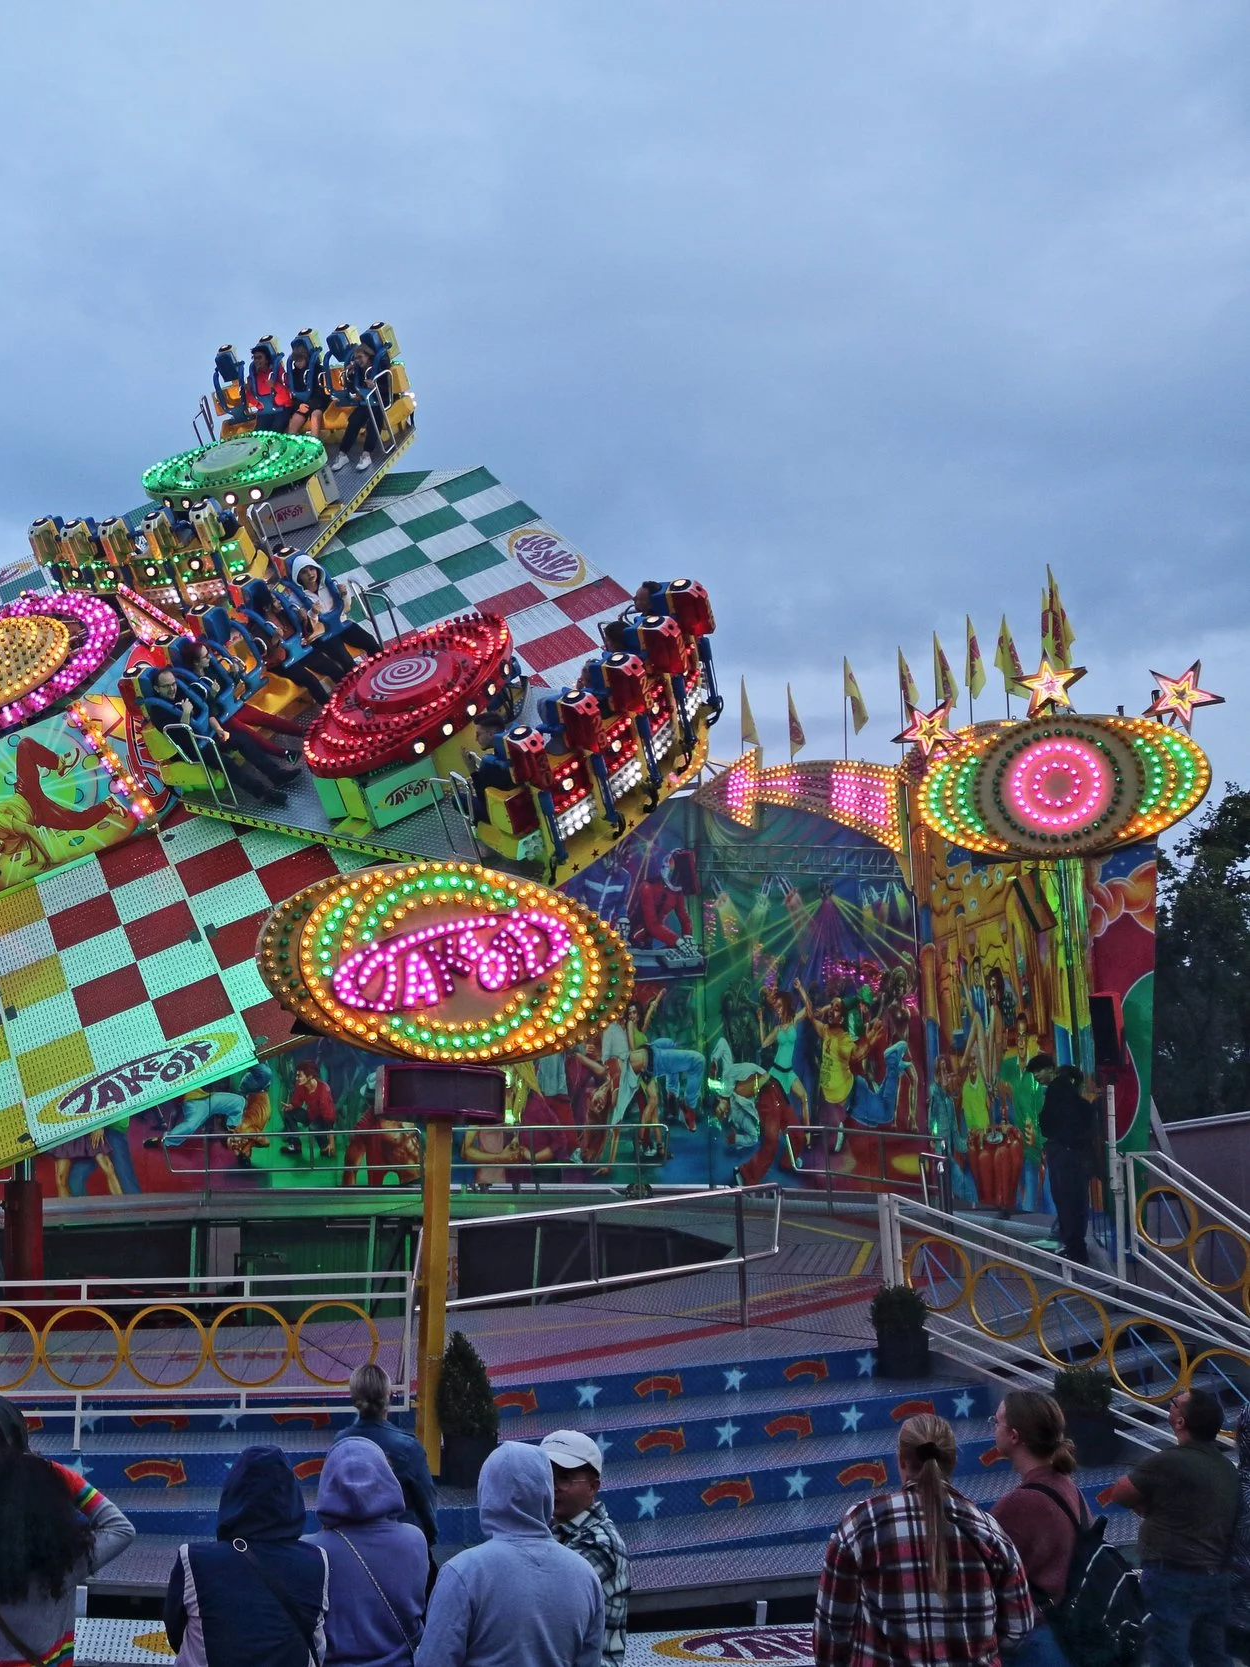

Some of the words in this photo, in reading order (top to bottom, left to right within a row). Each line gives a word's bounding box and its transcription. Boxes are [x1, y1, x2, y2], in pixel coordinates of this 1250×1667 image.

[334, 915, 498, 1011] TAKE
[58, 1047, 178, 1113] TAKE
[160, 1040, 213, 1083] OFF
